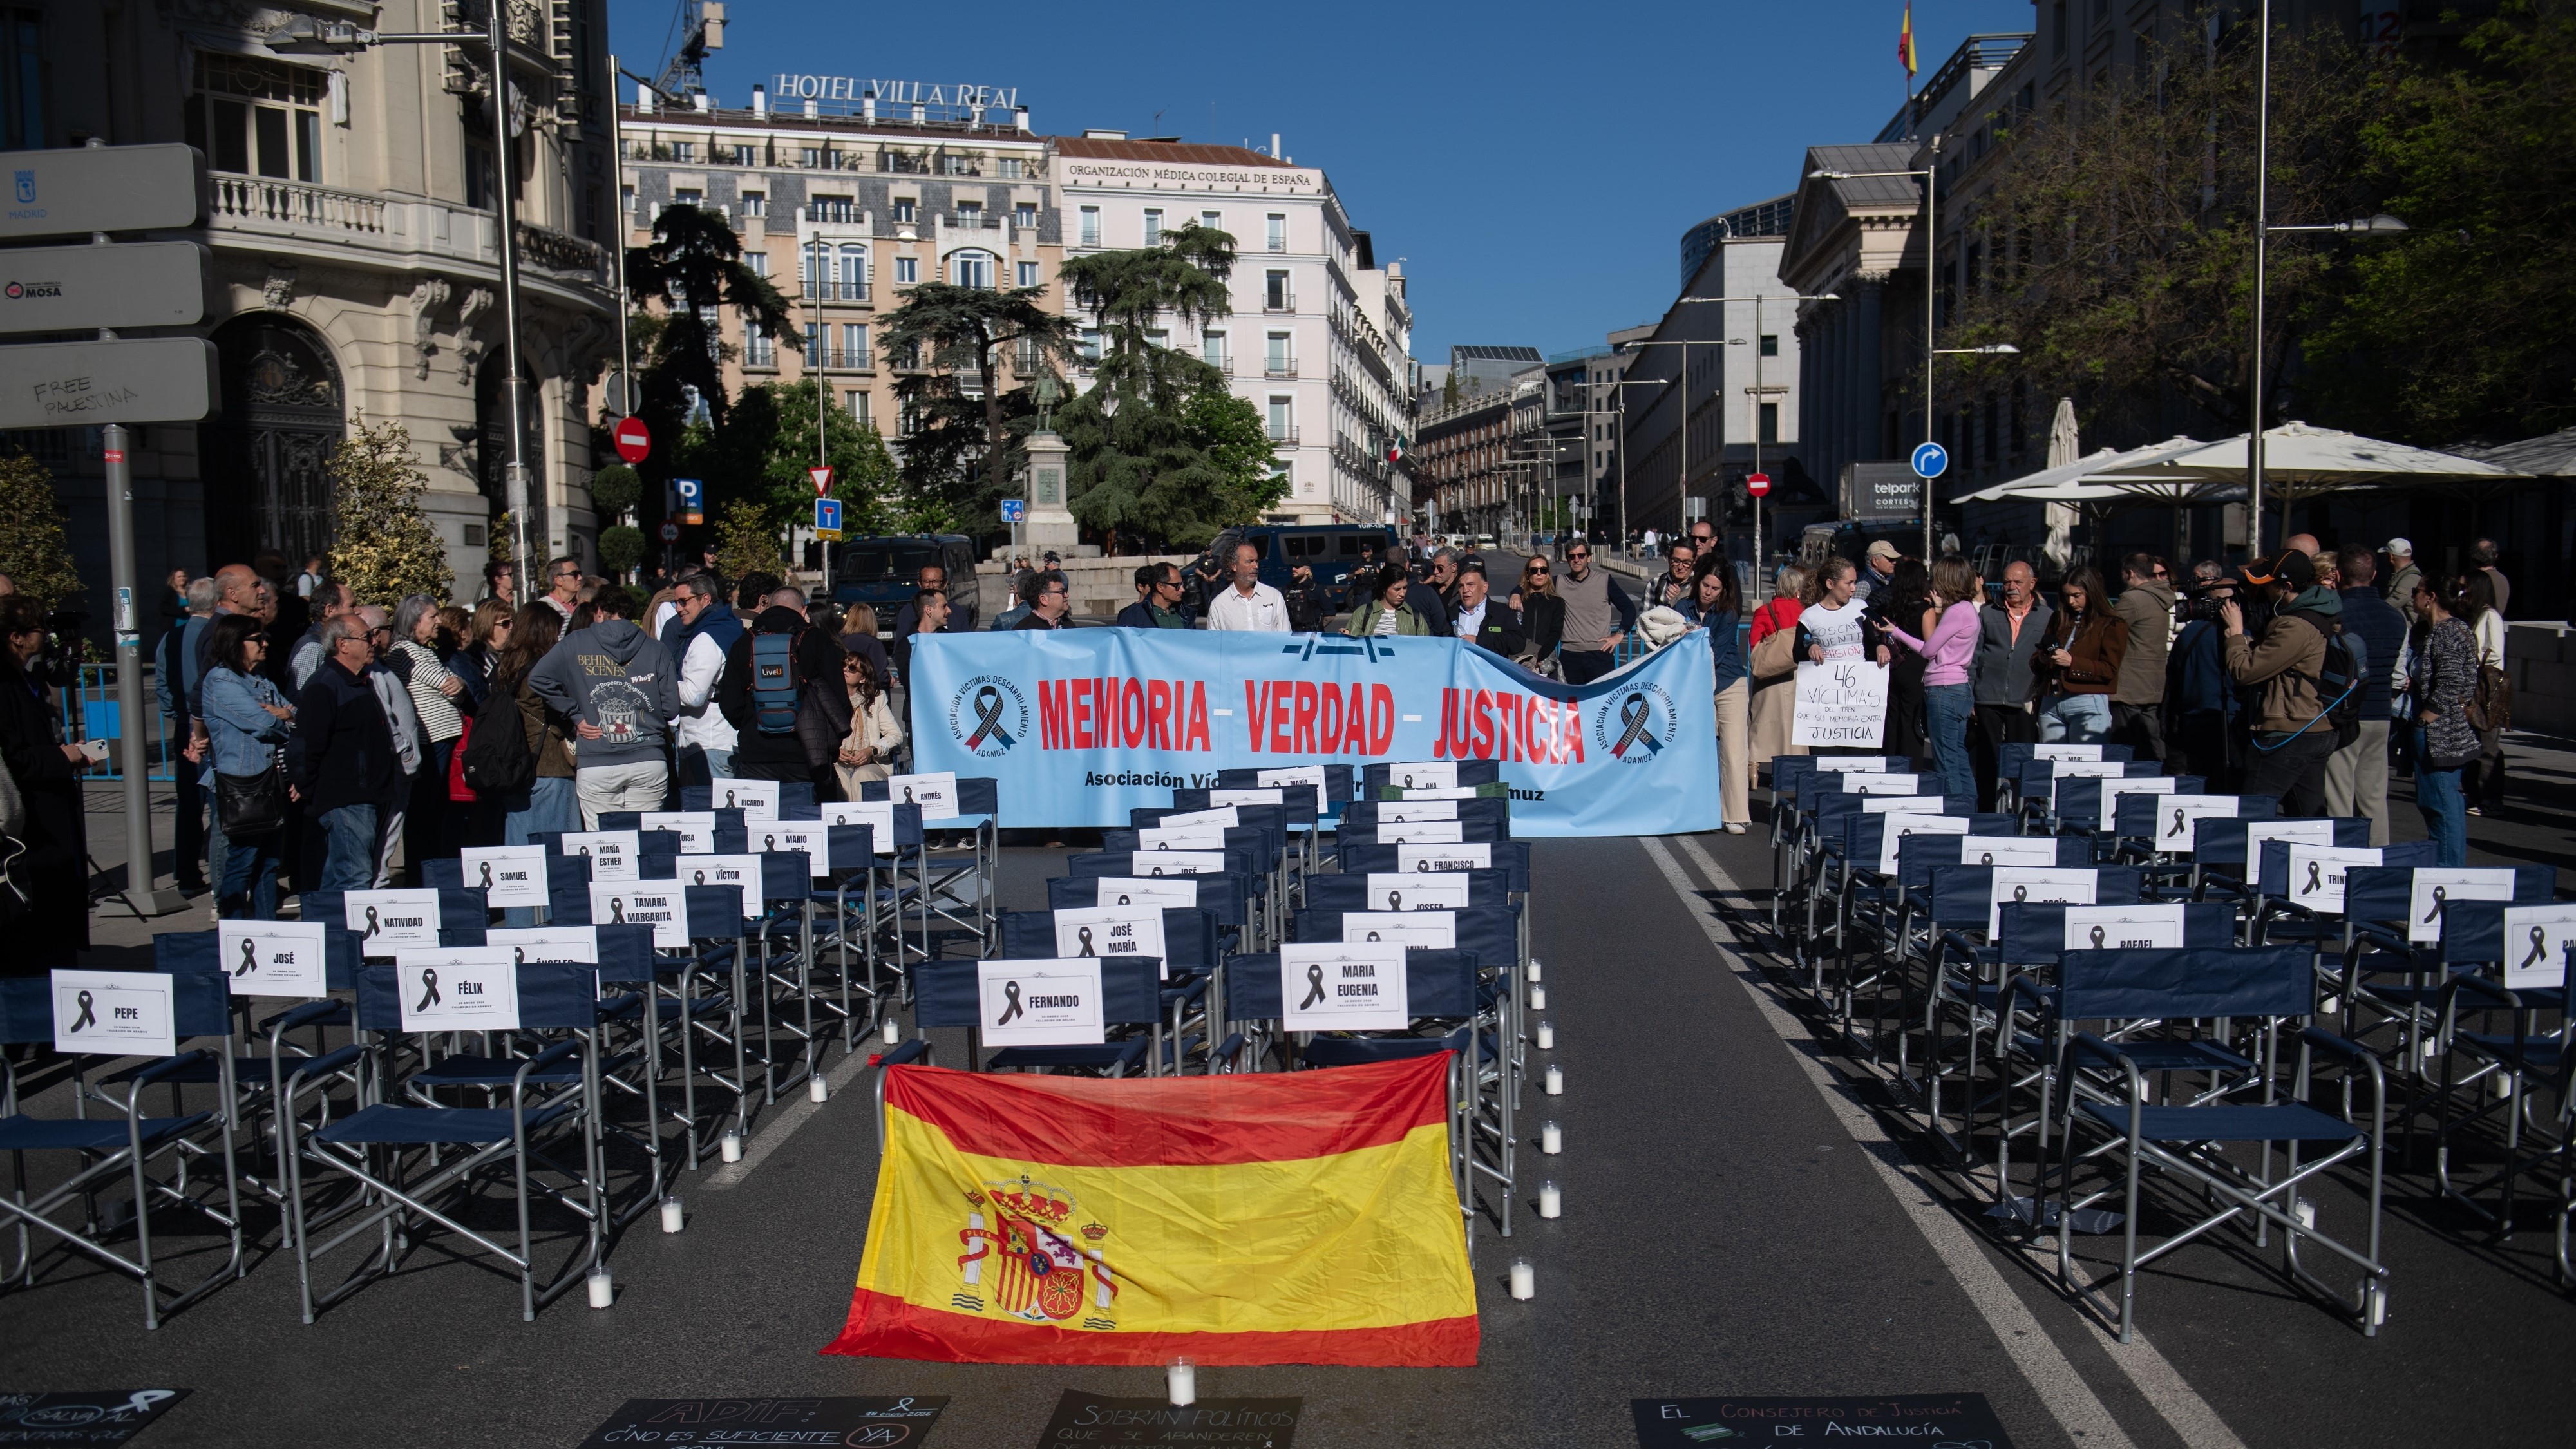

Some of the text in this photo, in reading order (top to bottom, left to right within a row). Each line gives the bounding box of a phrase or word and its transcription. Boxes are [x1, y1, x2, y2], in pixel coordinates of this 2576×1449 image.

[779, 73, 1020, 110] HOTEL VILLA REAL
[1070, 166, 1311, 185] ORGANIZACIÓN MÉDICA COLEGIAL DE ESPAÑA
[9, 209, 47, 220] MADRID
[26, 287, 62, 298] MOSA
[33, 376, 91, 402] FREE
[44, 386, 138, 415] PALESTINA
[679, 480, 697, 506] P
[1874, 482, 1921, 496] telpark
[1818, 621, 1859, 636] OSCAR
[585, 665, 626, 677] SCENES
[1834, 664, 1856, 688] 46
[1807, 684, 1881, 708] VÍCTIMAS
[950, 674, 1029, 740] ASOCIACIÓN VÍCTIMAS DESCARRILAMIENTO
[1038, 676, 1211, 752] MEMORIA
[1245, 680, 1395, 755] VERDAD
[1434, 687, 1585, 764] JUSTICIA
[1596, 681, 1677, 750] ASOCIACIÓN VÍCTIMAS DESCARRILAMIENTO
[976, 748, 1006, 758] ADAMUZ
[1622, 753, 1653, 764] ADAMUZ
[1085, 770, 1184, 788] Asociación
[1508, 788, 1544, 802] muz
[921, 791, 942, 800] ANDRÉS
[786, 835, 807, 844] MARIO
[599, 844, 620, 855] MARÍA
[600, 857, 621, 866] ESTHER
[1434, 860, 1474, 869] FRANCISCO
[500, 871, 528, 881] SAMUEL
[715, 869, 740, 880] VÍCTOR
[2328, 875, 2345, 885] TRIN
[634, 897, 667, 908] TAMARA
[384, 917, 423, 928] NATIVIDAD
[627, 911, 672, 922] MARGARITA
[1110, 923, 1132, 936] JOSÉ
[1108, 939, 1137, 954] MARÍA
[273, 951, 294, 965] JOSÉ
[1342, 965, 1375, 978] MARIA
[458, 980, 484, 995] FÉLIX
[1337, 983, 1378, 997] EUGENIA
[1029, 995, 1079, 1008] FERNANDO
[115, 1007, 138, 1019] PEPE
[967, 1229, 990, 1238] PLVS
[100, 1412, 136, 1422] AL
[1074, 1405, 1294, 1426] SOBRAN POLÍTICOS
[1661, 1404, 1690, 1419] EL
[1721, 1403, 1845, 1419] CONSEJERO
[1857, 1407, 1880, 1417] DE
[665, 1431, 697, 1441] ES
[706, 1430, 840, 1441] SUFICIENTE
[858, 1427, 896, 1442] YA
[1057, 1428, 1273, 1441] QUE SE ABANDEREN
[1775, 1421, 1945, 1436] DE ANDALUCÍA
